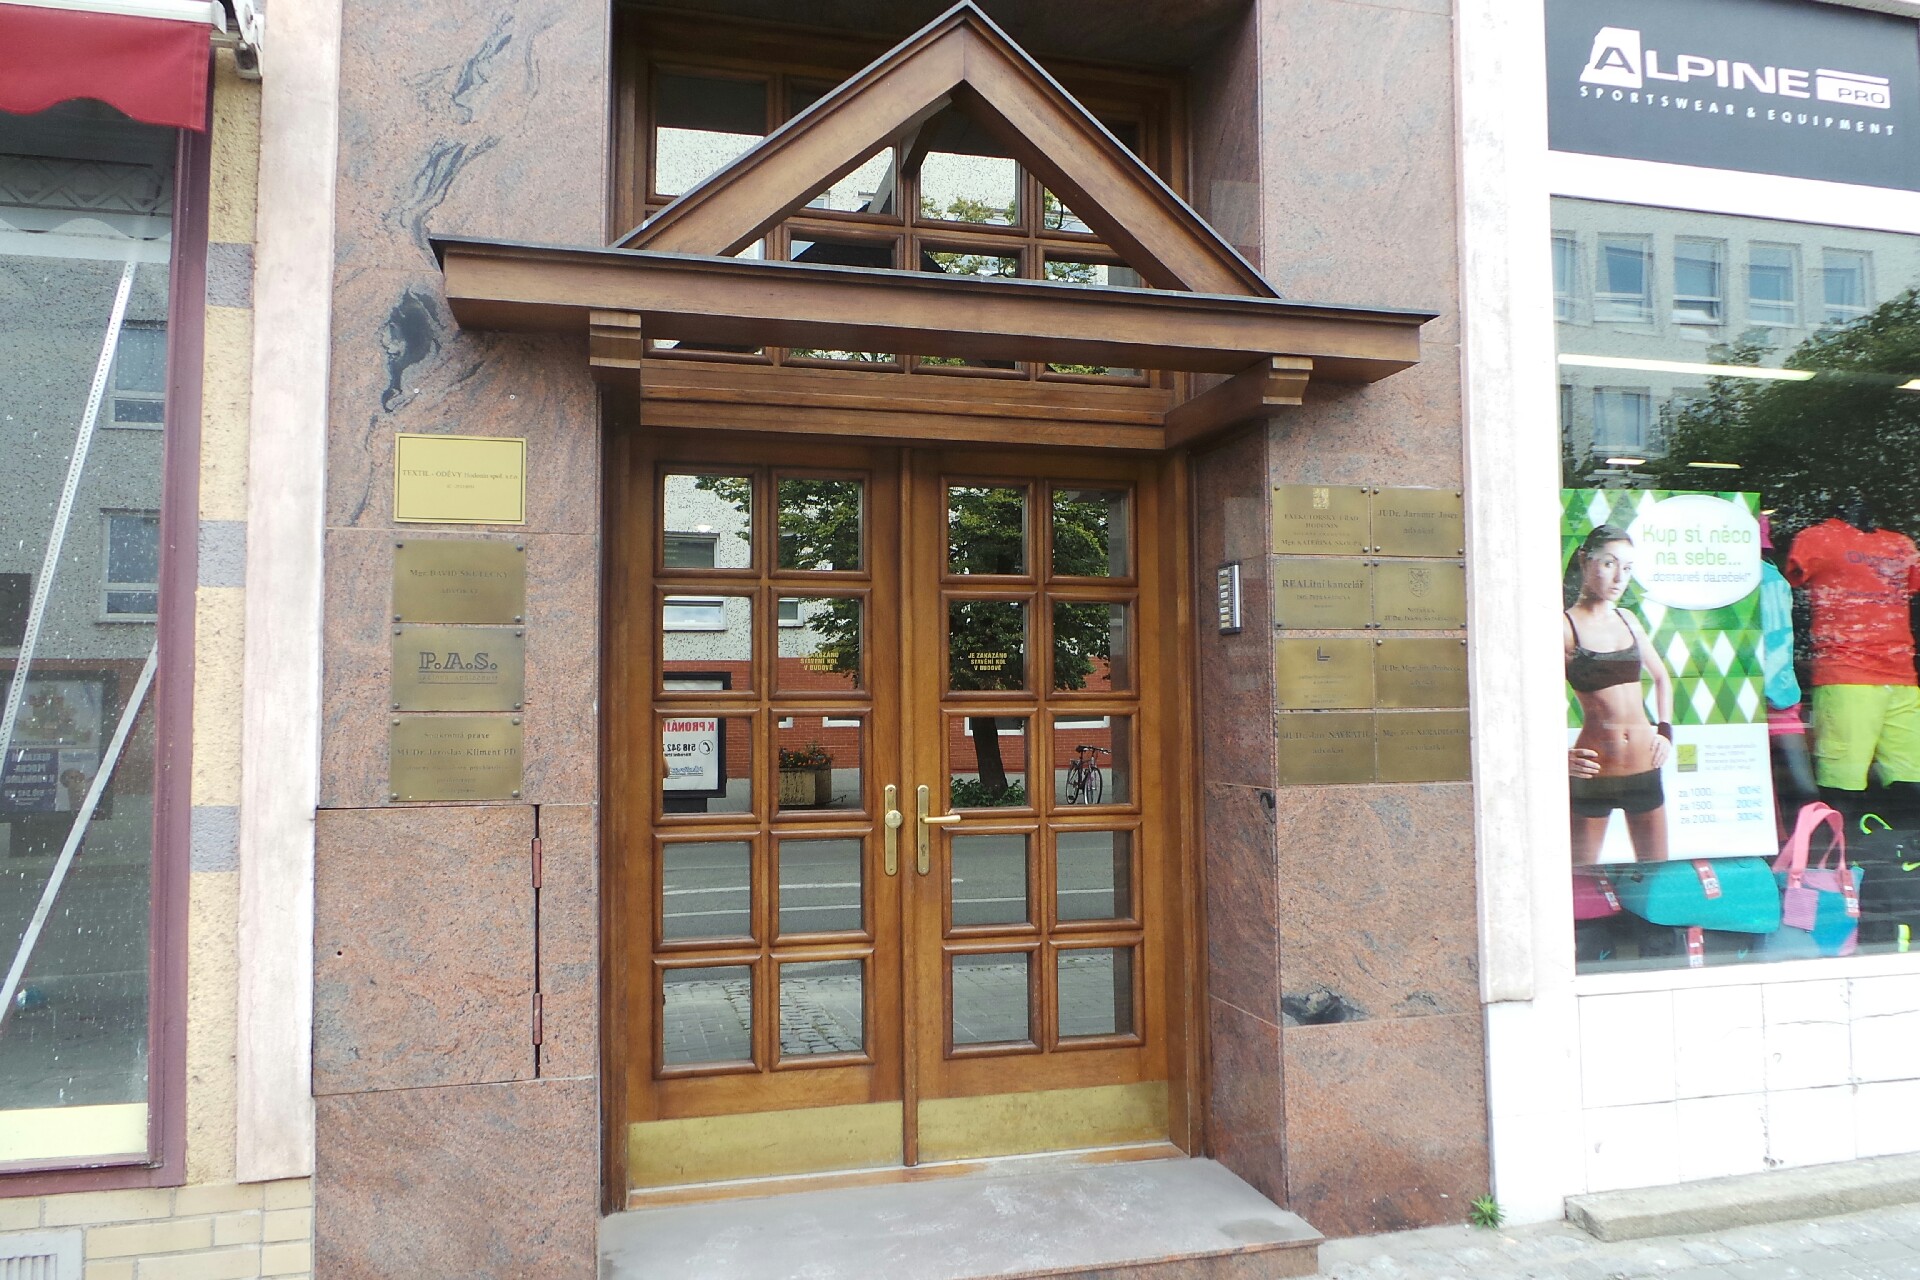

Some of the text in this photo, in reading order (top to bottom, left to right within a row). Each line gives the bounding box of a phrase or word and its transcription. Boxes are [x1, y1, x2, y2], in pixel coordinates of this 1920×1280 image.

[1579, 26, 1887, 105] ALPINE PRO
[1579, 85, 1895, 137] SPORTSWEAR & EQUIPMENT
[1642, 523, 1751, 547] Kup si něco
[1655, 546, 1742, 566] na sebe...
[418, 651, 498, 670] P.A.S.
[466, 748, 501, 757] Kliment
